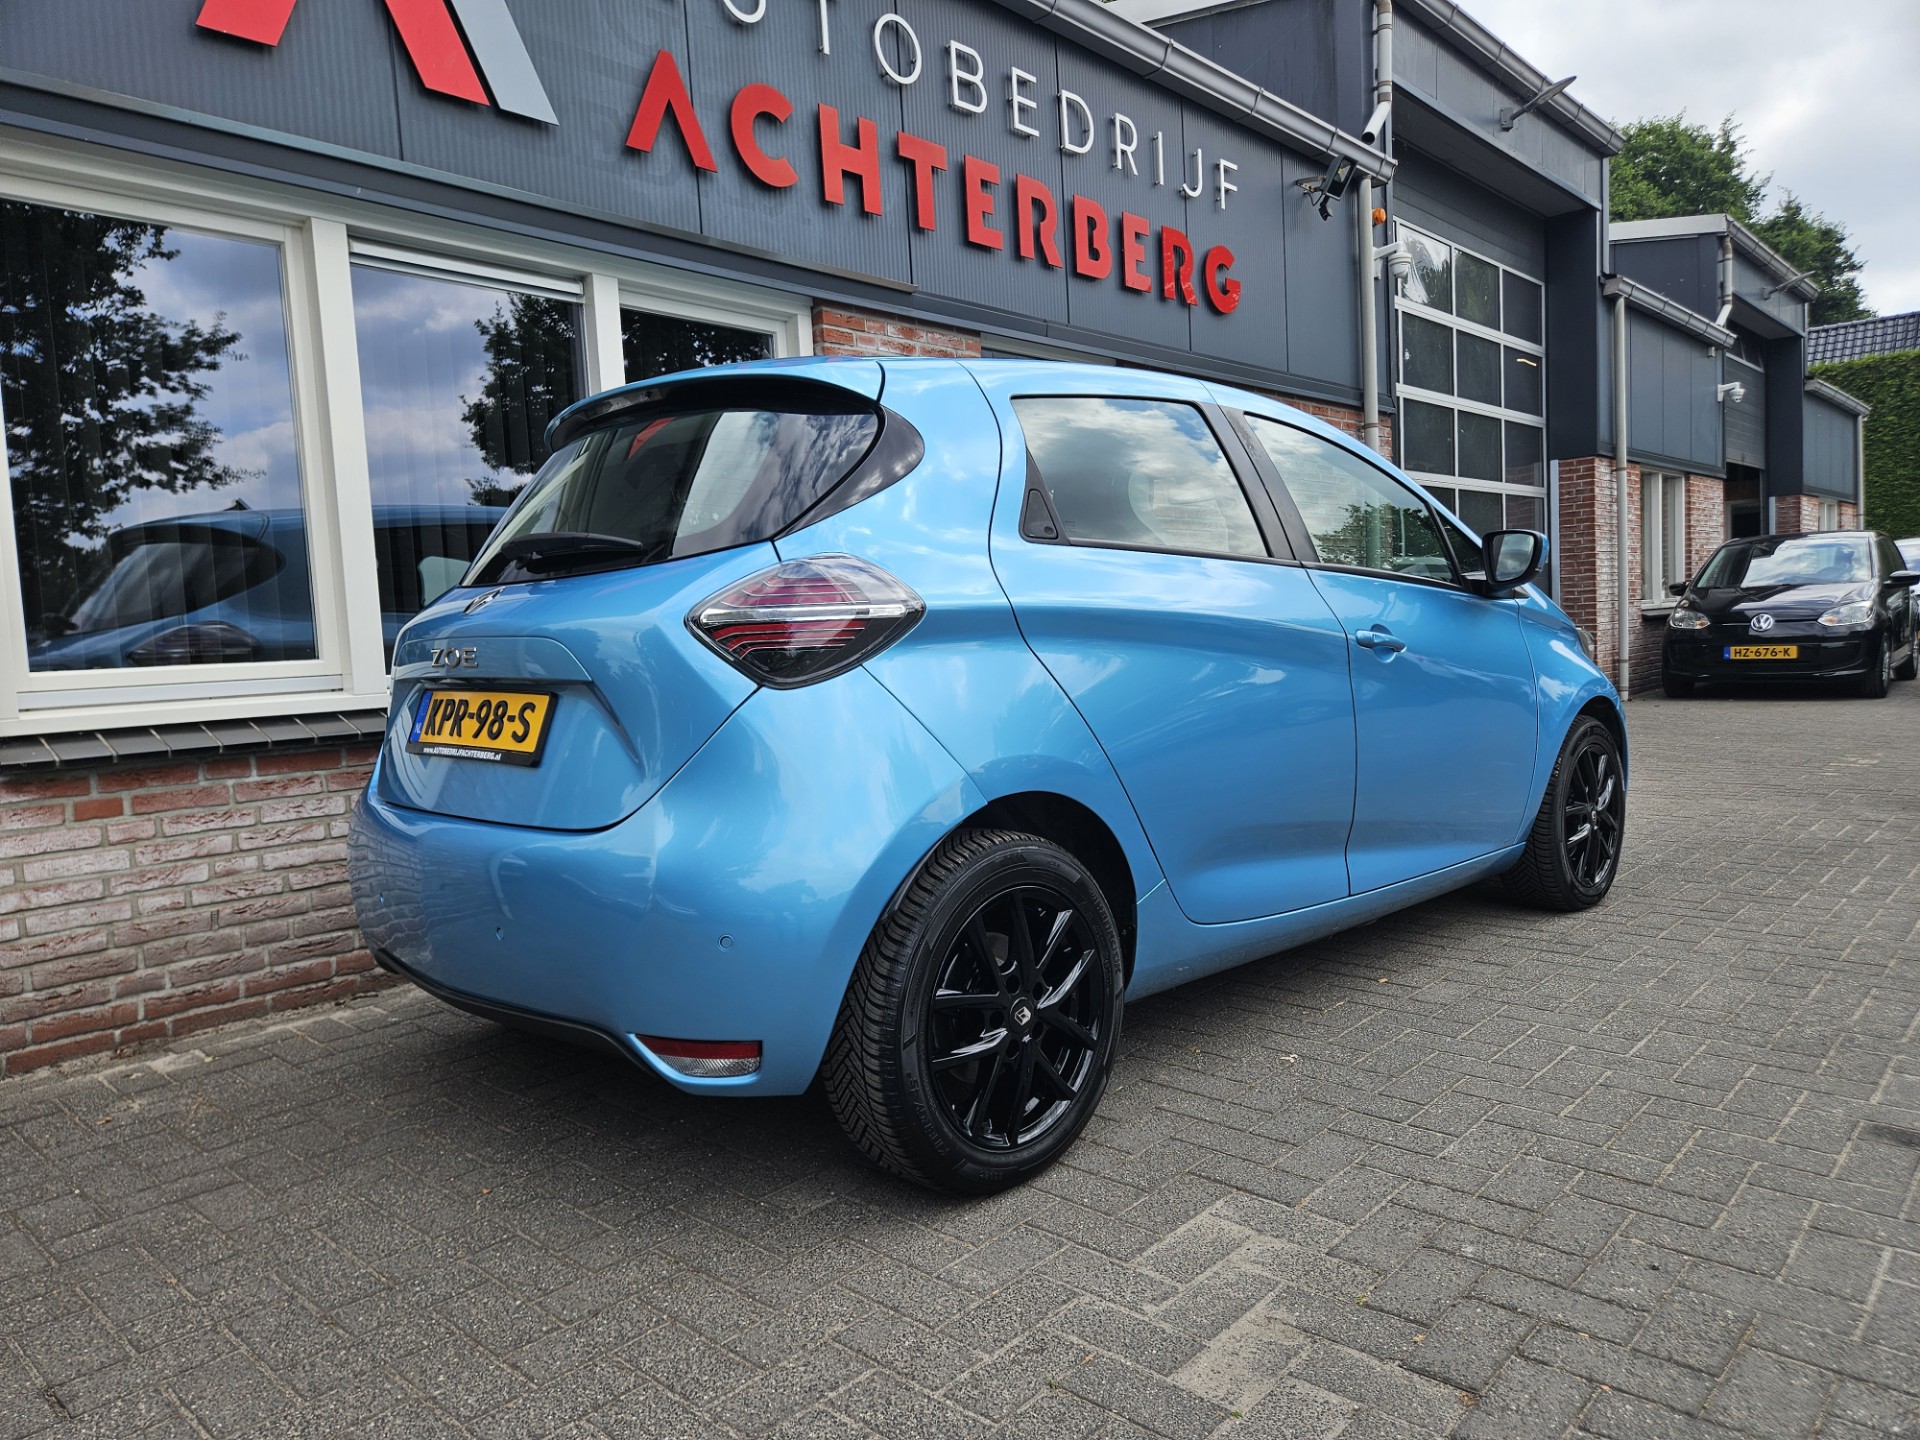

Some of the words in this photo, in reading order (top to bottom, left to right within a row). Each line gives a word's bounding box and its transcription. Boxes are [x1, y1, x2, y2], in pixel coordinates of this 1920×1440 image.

[625, 50, 1241, 315] ACHTERBERG
[431, 647, 478, 669] ZOE
[1734, 647, 1791, 658] HZ-676-K
[424, 698, 536, 743] KPR-98-S
